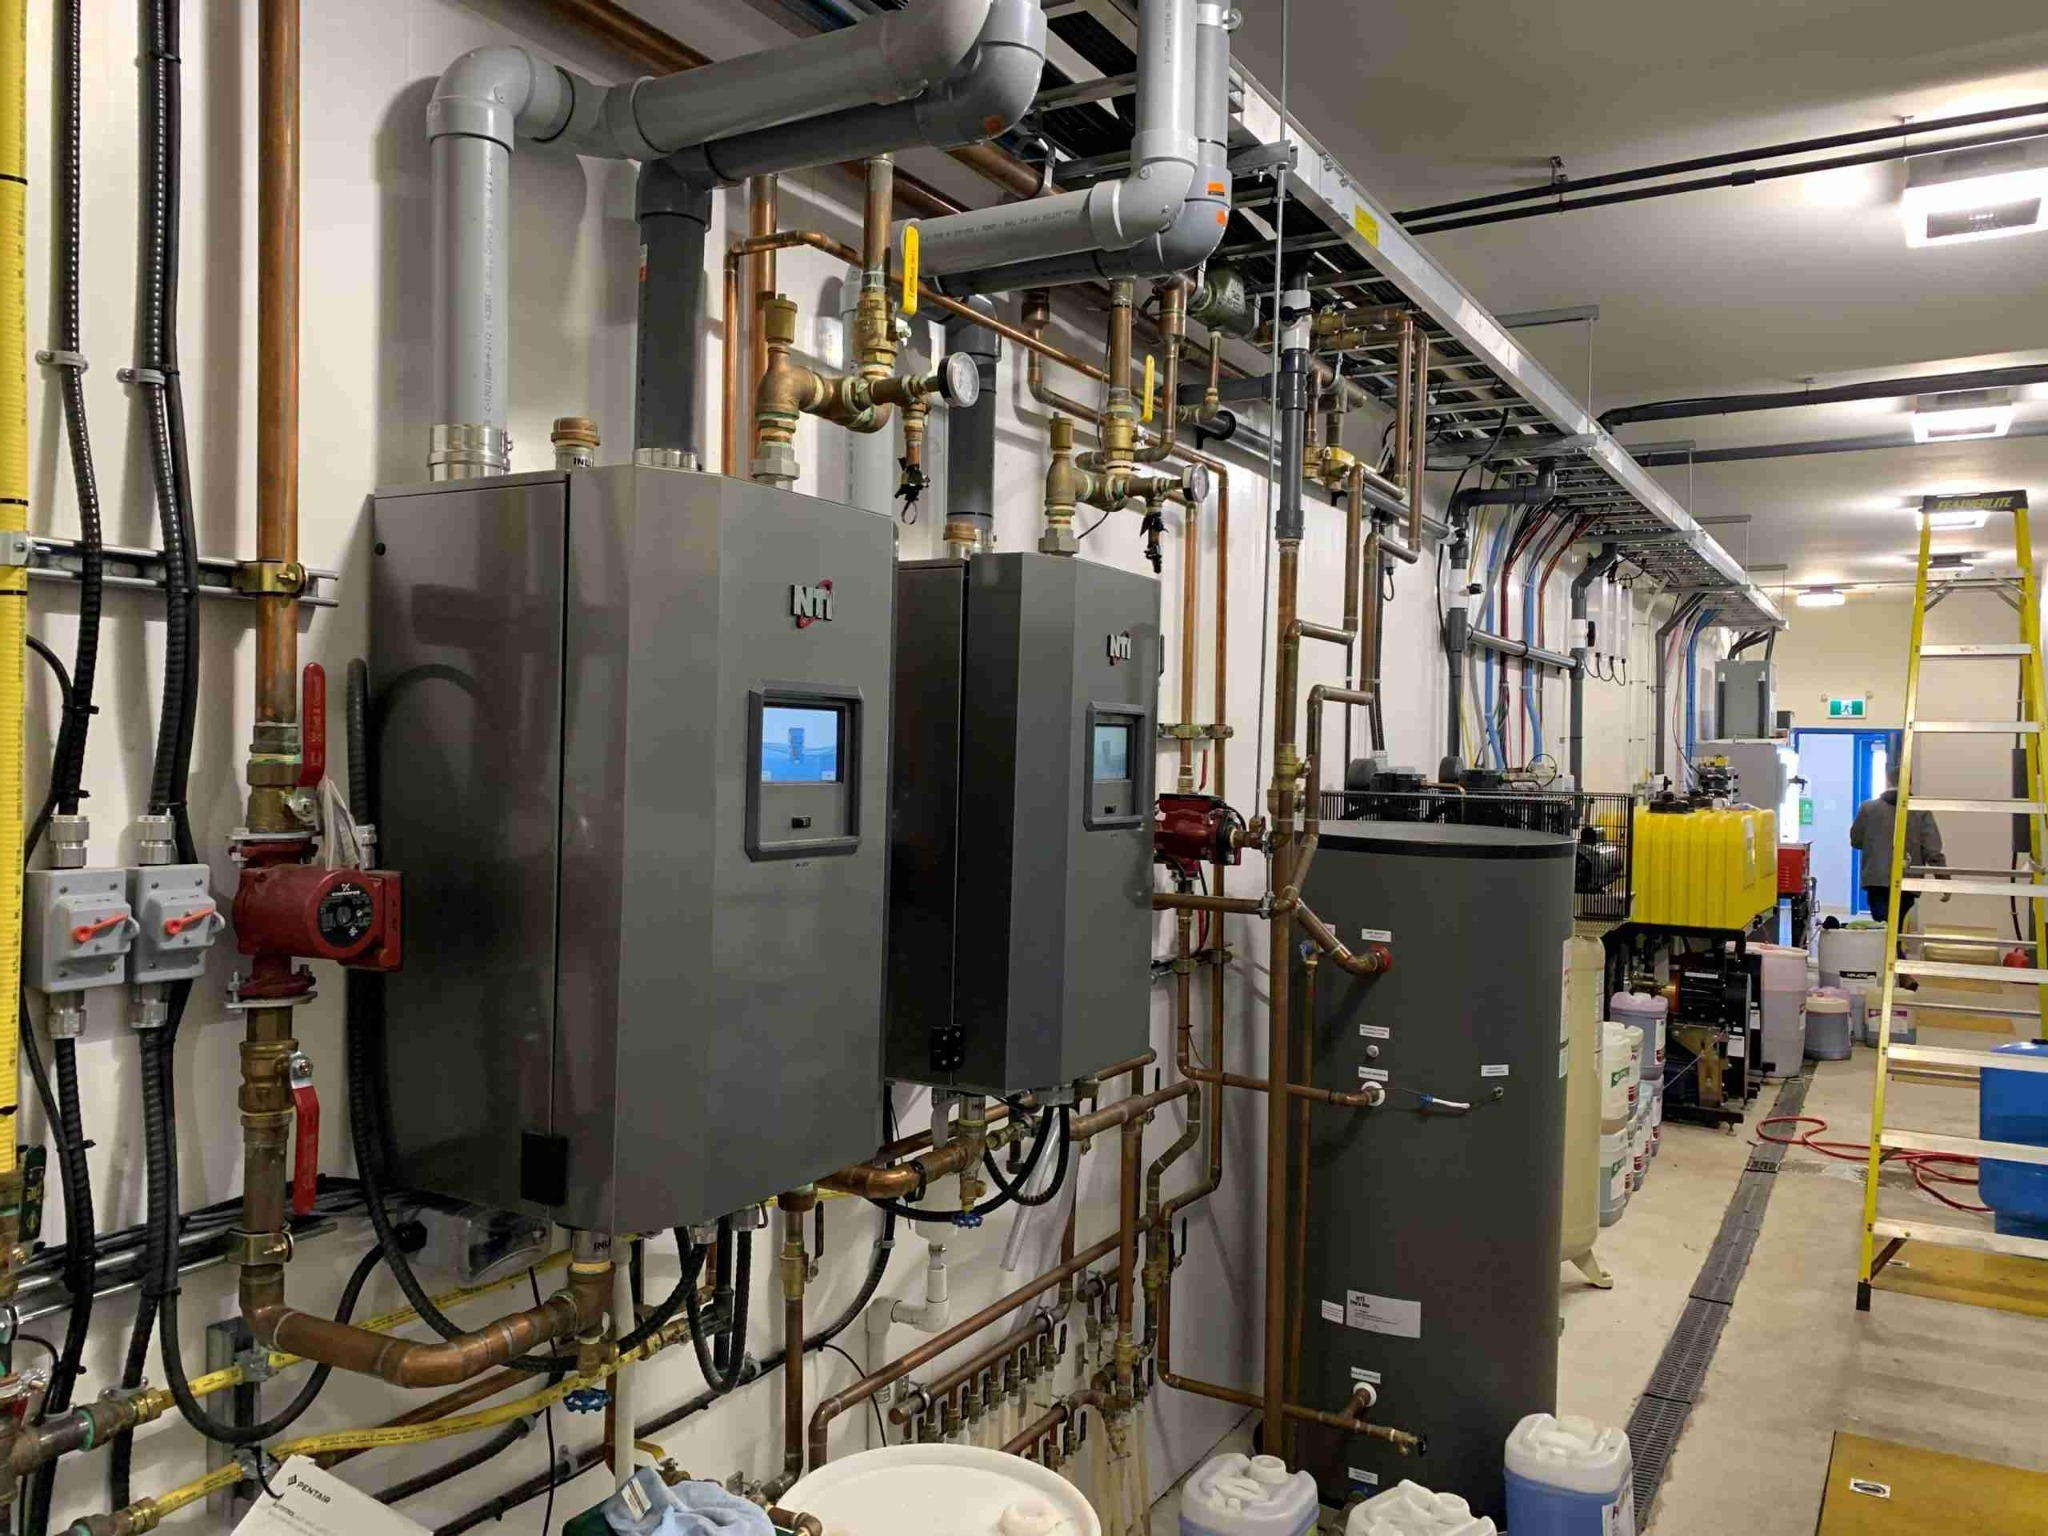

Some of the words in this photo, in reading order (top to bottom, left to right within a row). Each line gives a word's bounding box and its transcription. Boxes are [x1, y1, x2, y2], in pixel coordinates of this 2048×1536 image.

[791, 584, 833, 621] NTI
[1107, 634, 1132, 660] NTI
[296, 1481, 332, 1504] PENTAIR
